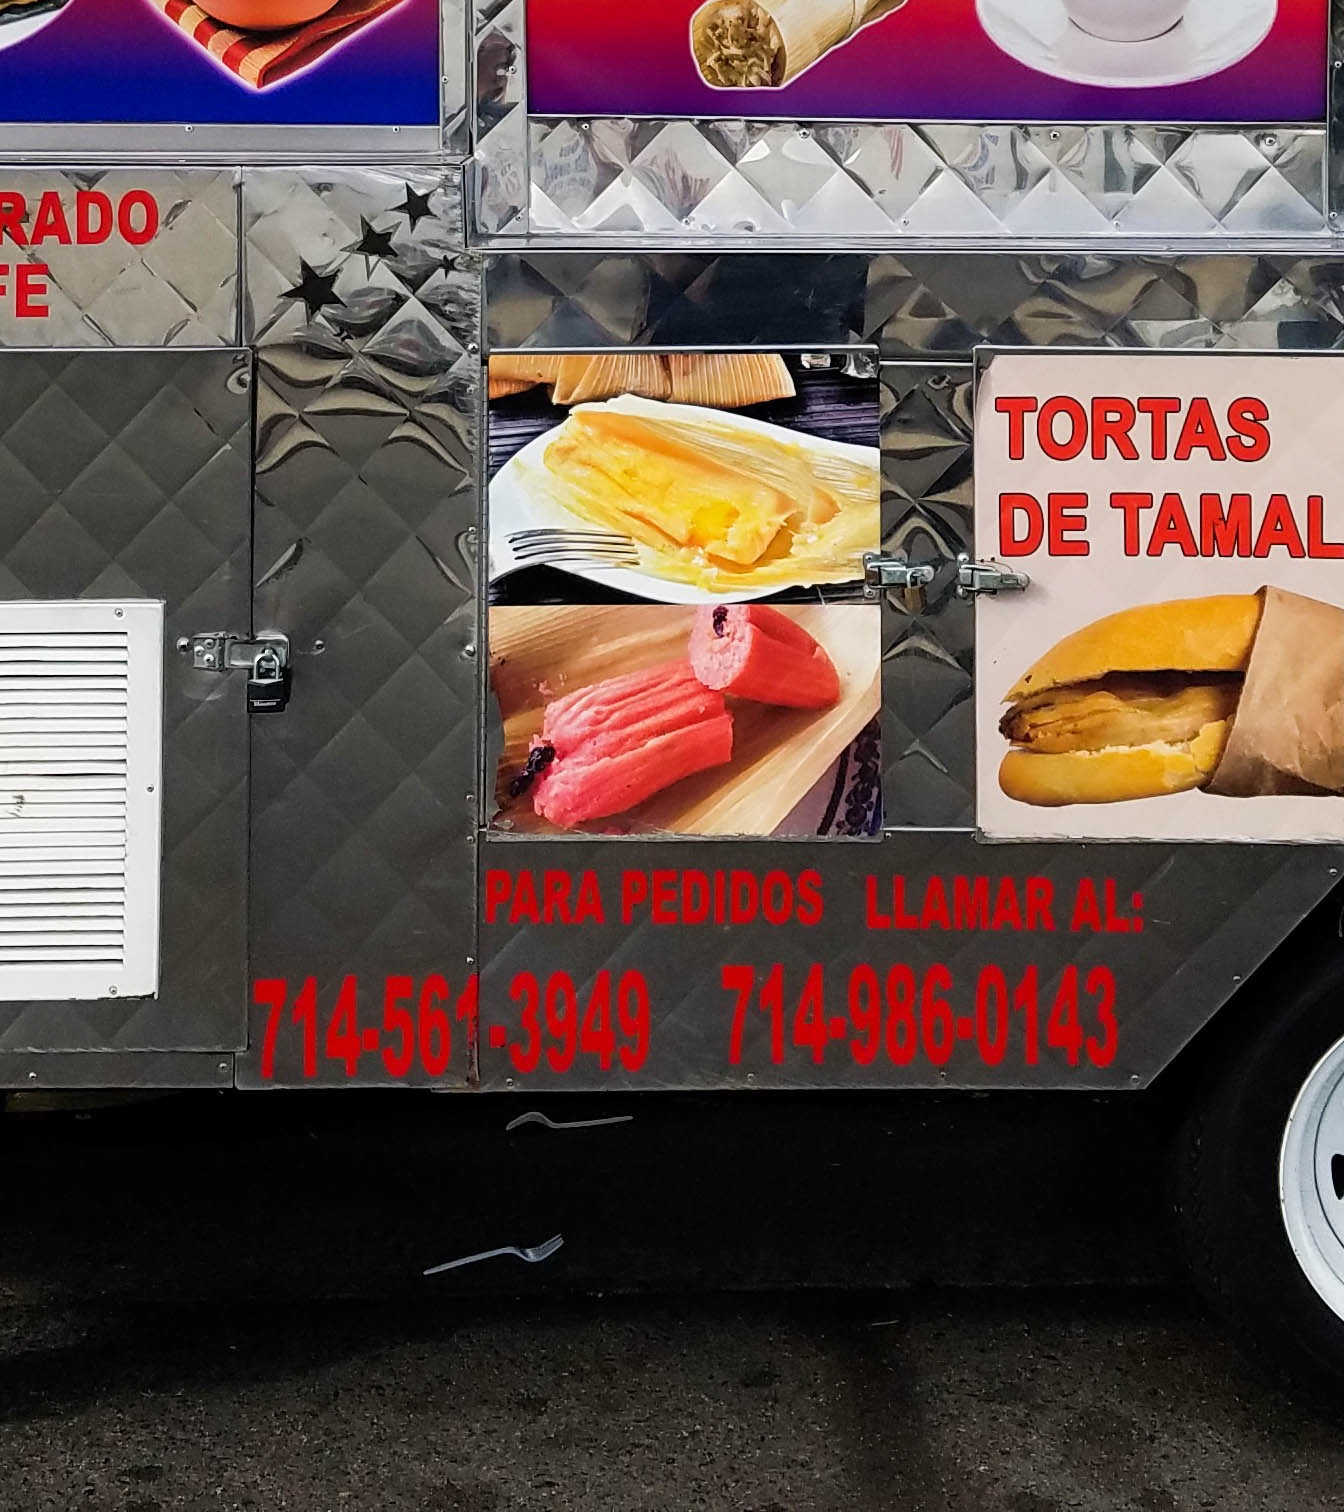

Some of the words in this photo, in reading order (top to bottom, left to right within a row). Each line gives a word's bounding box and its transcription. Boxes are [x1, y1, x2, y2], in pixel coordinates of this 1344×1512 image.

[995, 396, 1271, 462] TORTAS
[999, 492, 1090, 557] DE
[484, 869, 606, 925] PARA
[621, 869, 824, 926] PEDIDOS
[866, 875, 1056, 932] LLAMAR
[1070, 877, 1144, 933] AL:
[254, 969, 651, 1079] 714-561-3949
[721, 962, 1119, 1068] 714-986-0143
